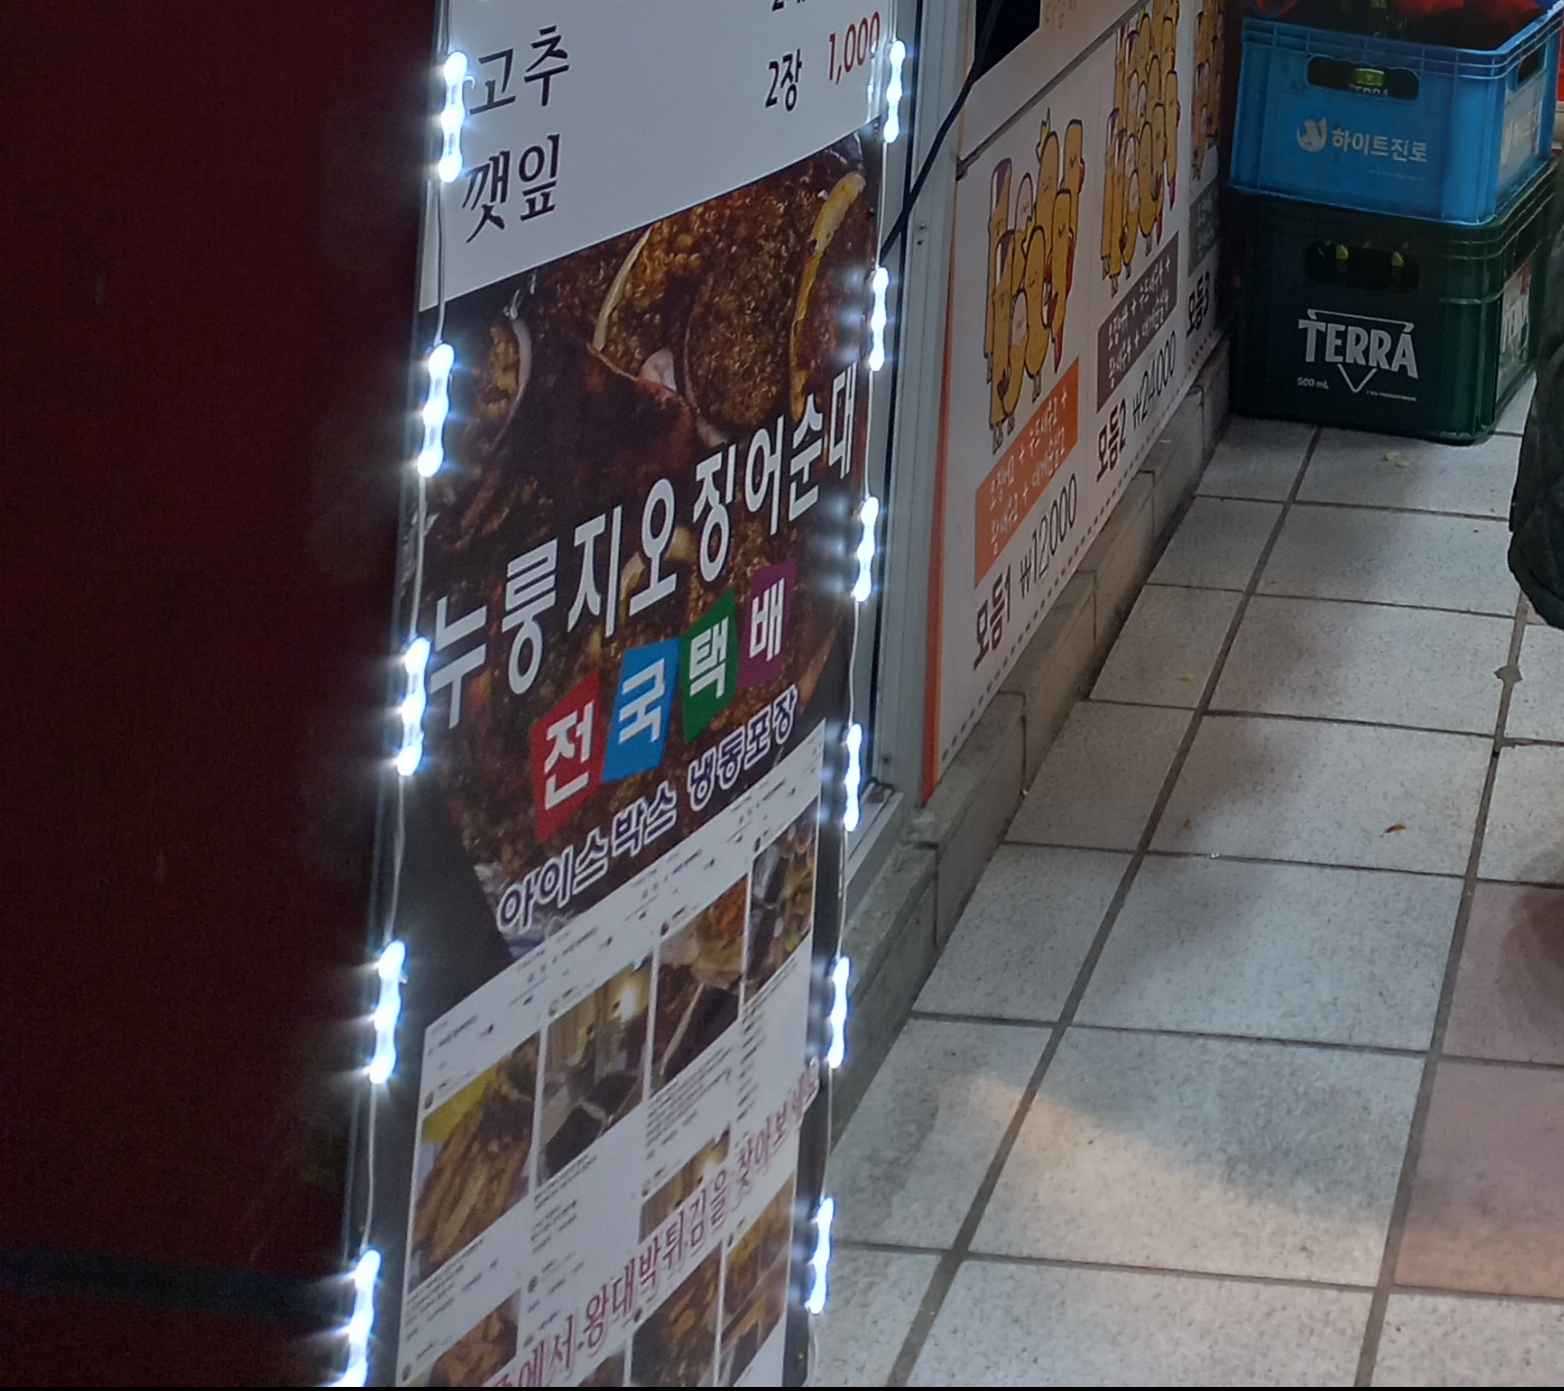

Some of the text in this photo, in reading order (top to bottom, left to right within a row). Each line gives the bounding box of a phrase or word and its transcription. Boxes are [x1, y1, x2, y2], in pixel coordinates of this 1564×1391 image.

[462, 12, 881, 243] 깻잎 2장 1,000
[469, 24, 569, 115] 고추
[1332, 127, 1428, 163] 하이트진로
[1298, 317, 1419, 380] TERRA
[543, 578, 786, 811] 전국택배
[497, 683, 798, 933] 아이스박스 냉동포장
